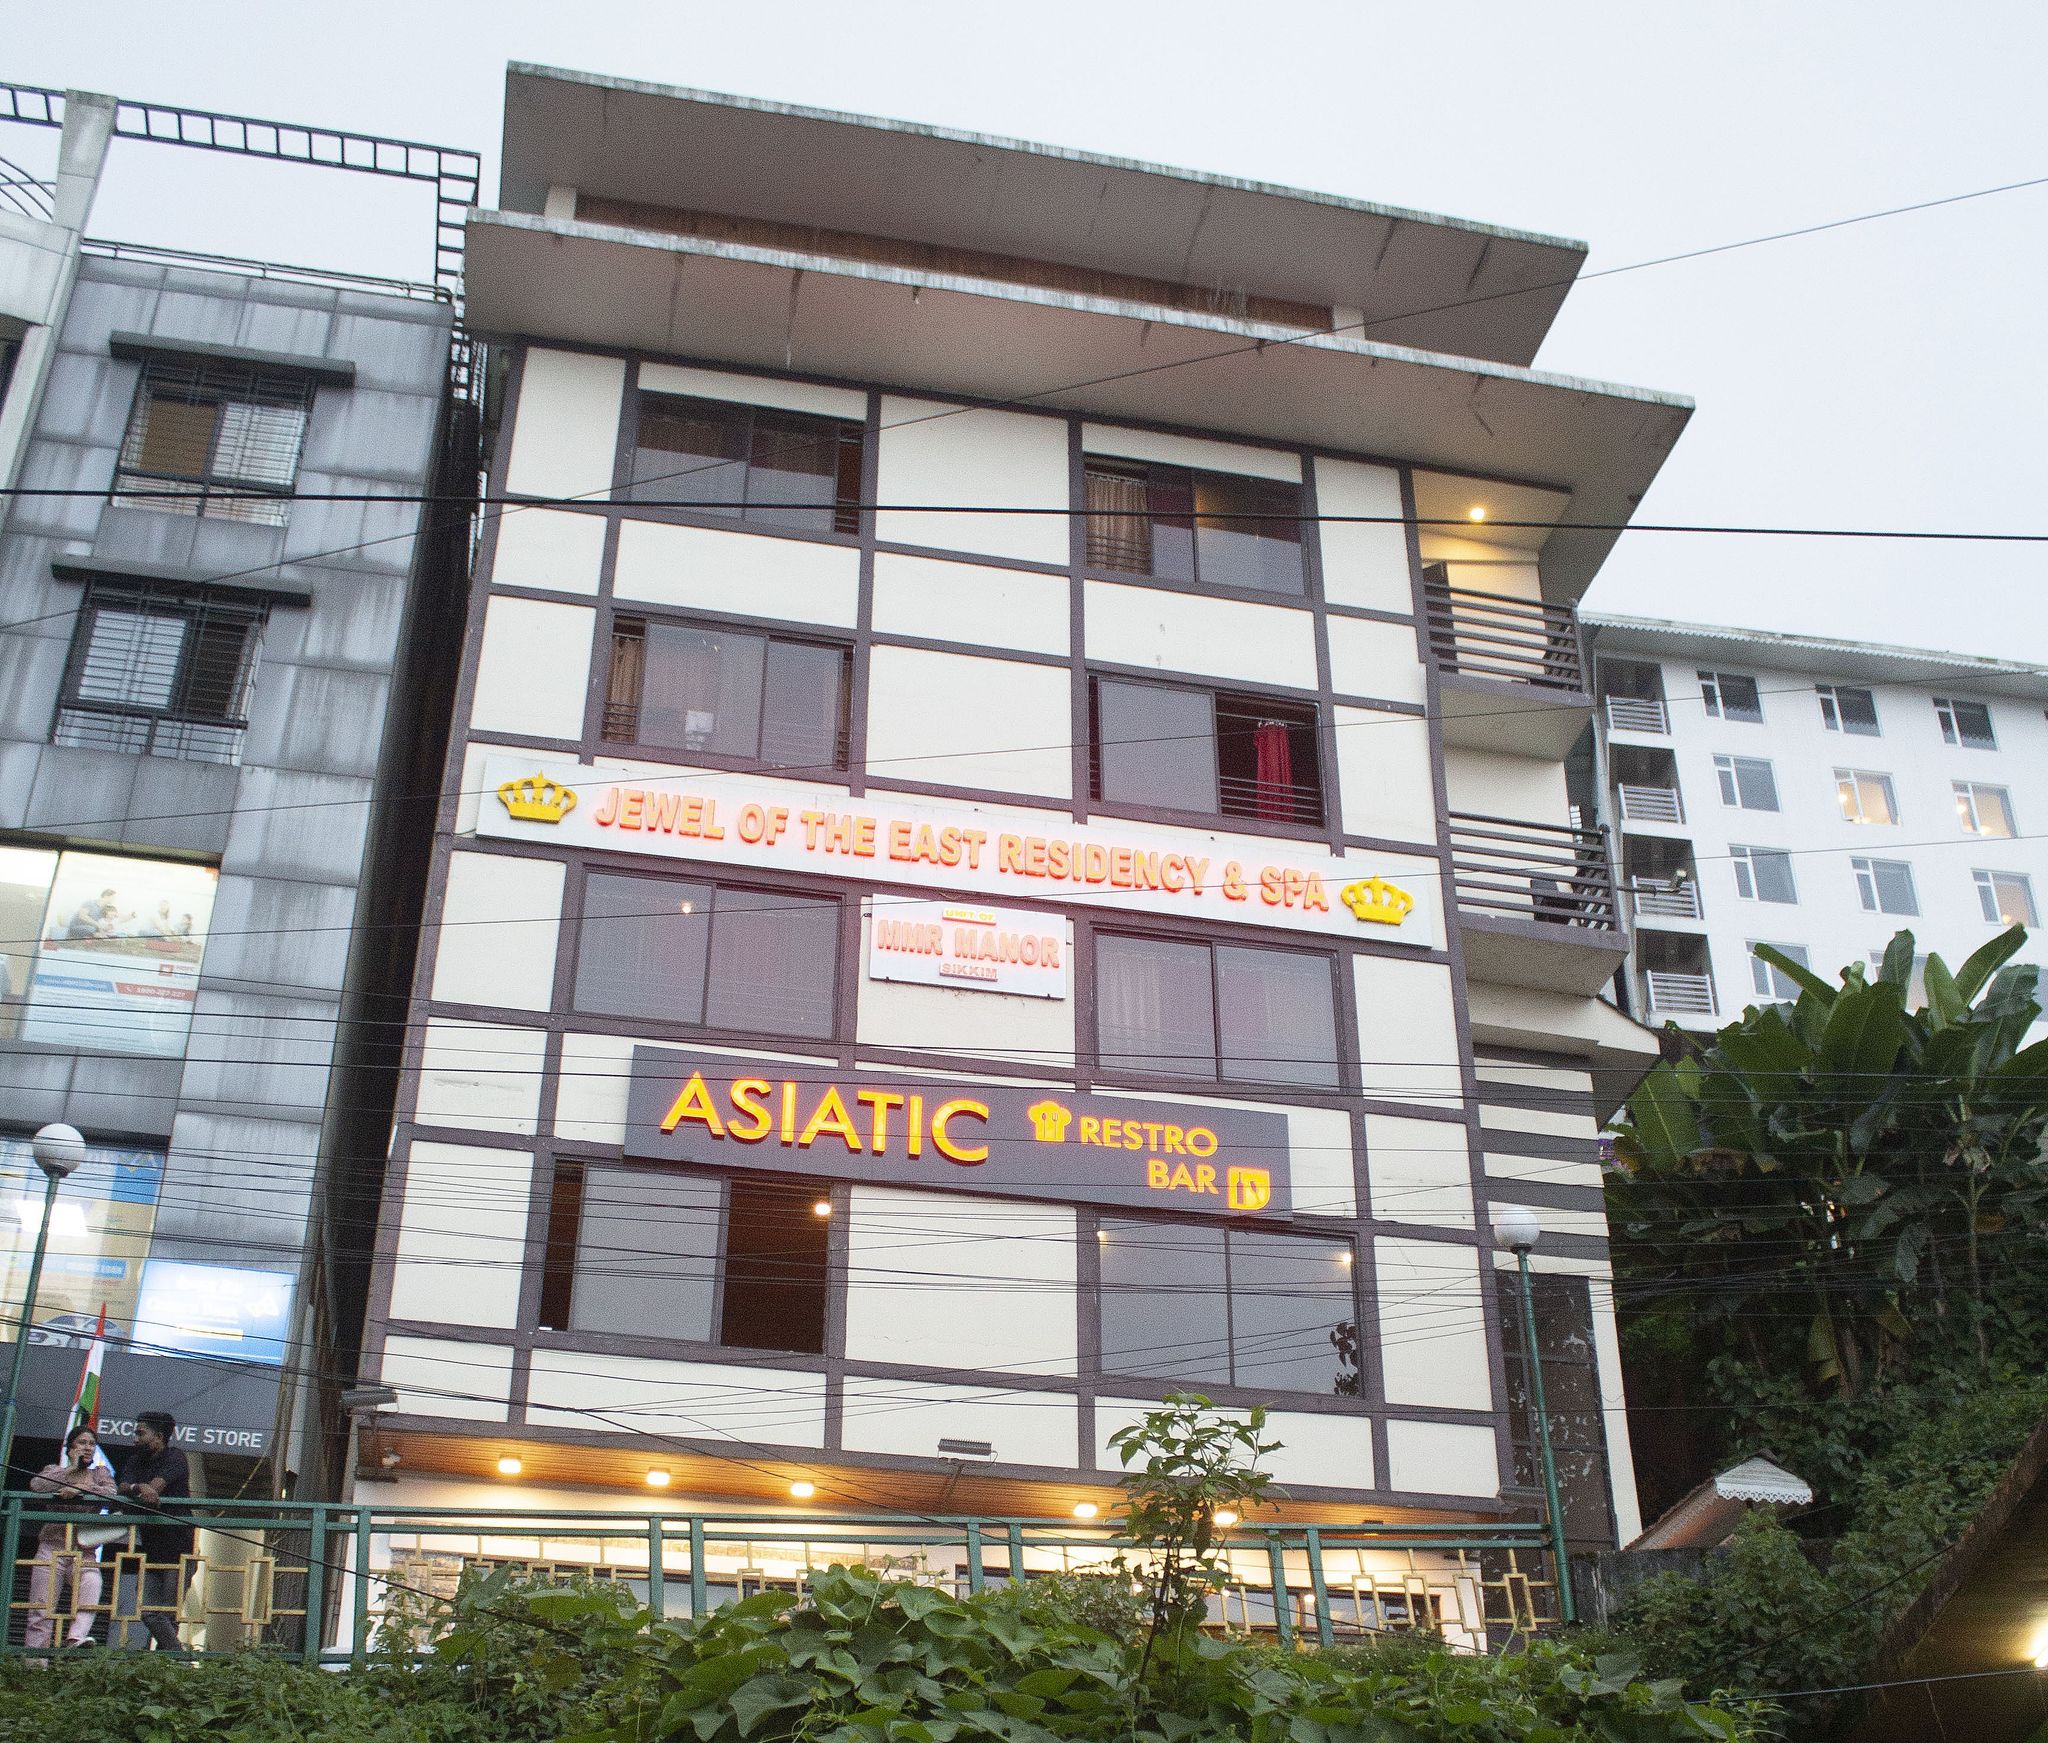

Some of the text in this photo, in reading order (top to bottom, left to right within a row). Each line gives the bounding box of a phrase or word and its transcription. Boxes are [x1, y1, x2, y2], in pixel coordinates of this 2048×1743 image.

[595, 788, 1330, 911] JEWEL OF THE EAST RESIDENCY & SPA
[878, 919, 1060, 969] MMR MANOR
[941, 963, 998, 978] SIKKIM
[660, 1071, 990, 1165] ASIATIC
[1081, 1117, 1218, 1158] RESTRO
[1147, 1160, 1216, 1194] BAR
[97, 1419, 263, 1448] EXCVE STORE
